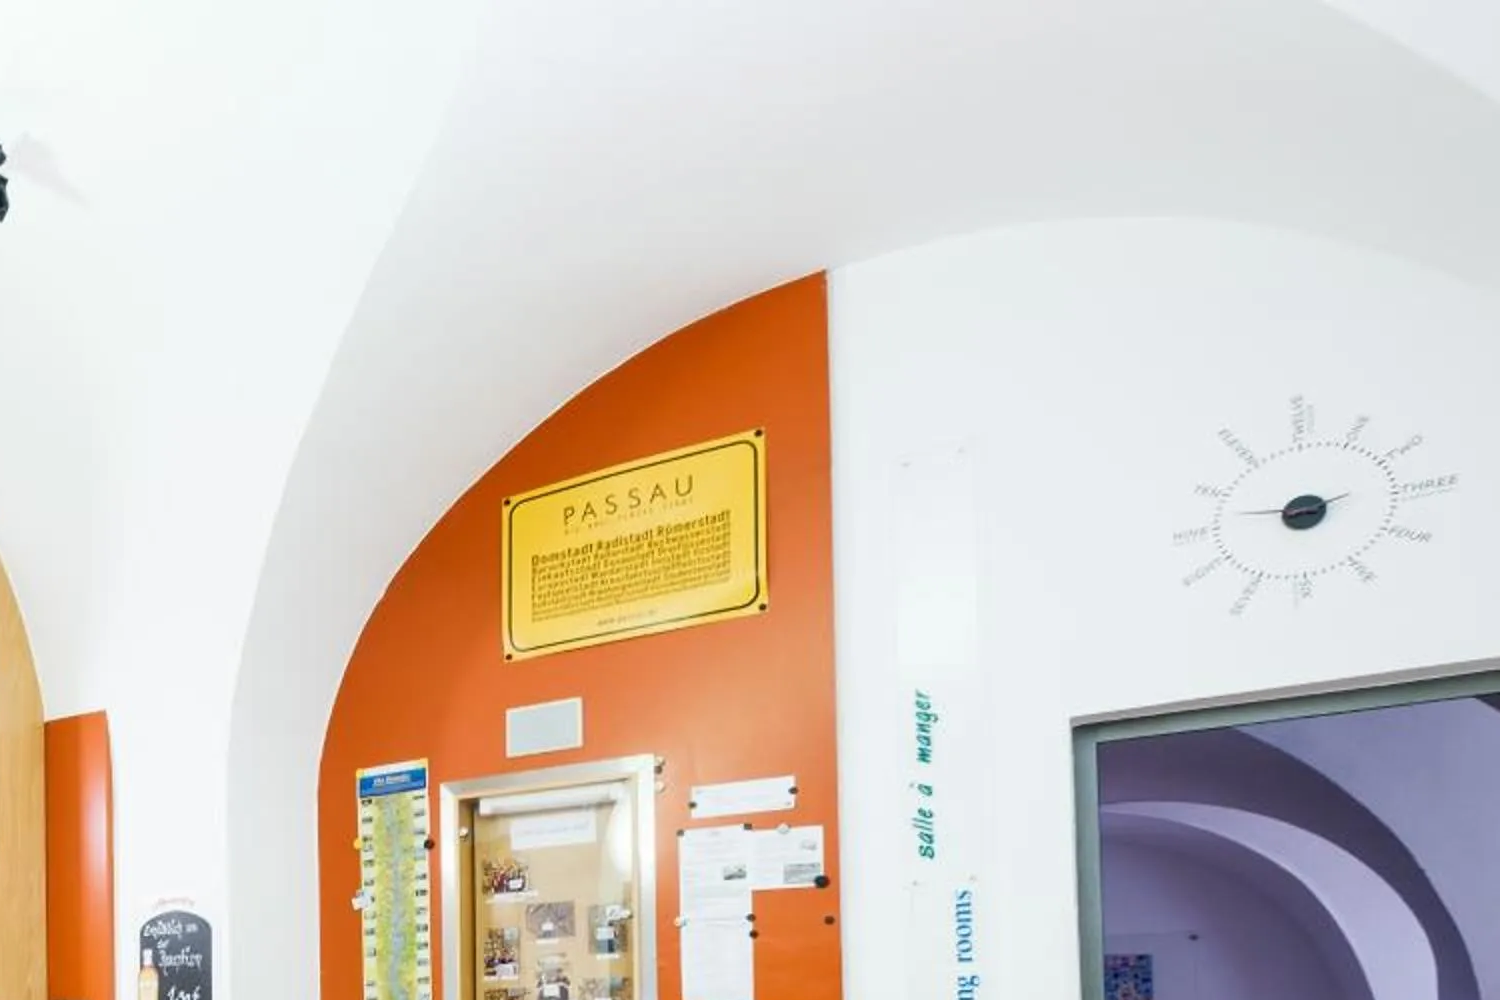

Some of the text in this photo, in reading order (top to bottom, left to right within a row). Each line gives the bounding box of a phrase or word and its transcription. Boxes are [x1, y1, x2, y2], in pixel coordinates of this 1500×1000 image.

[562, 474, 695, 527] PASSAU
[914, 688, 940, 765] manger
[911, 806, 935, 861] salle
[954, 888, 974, 965] rooms
